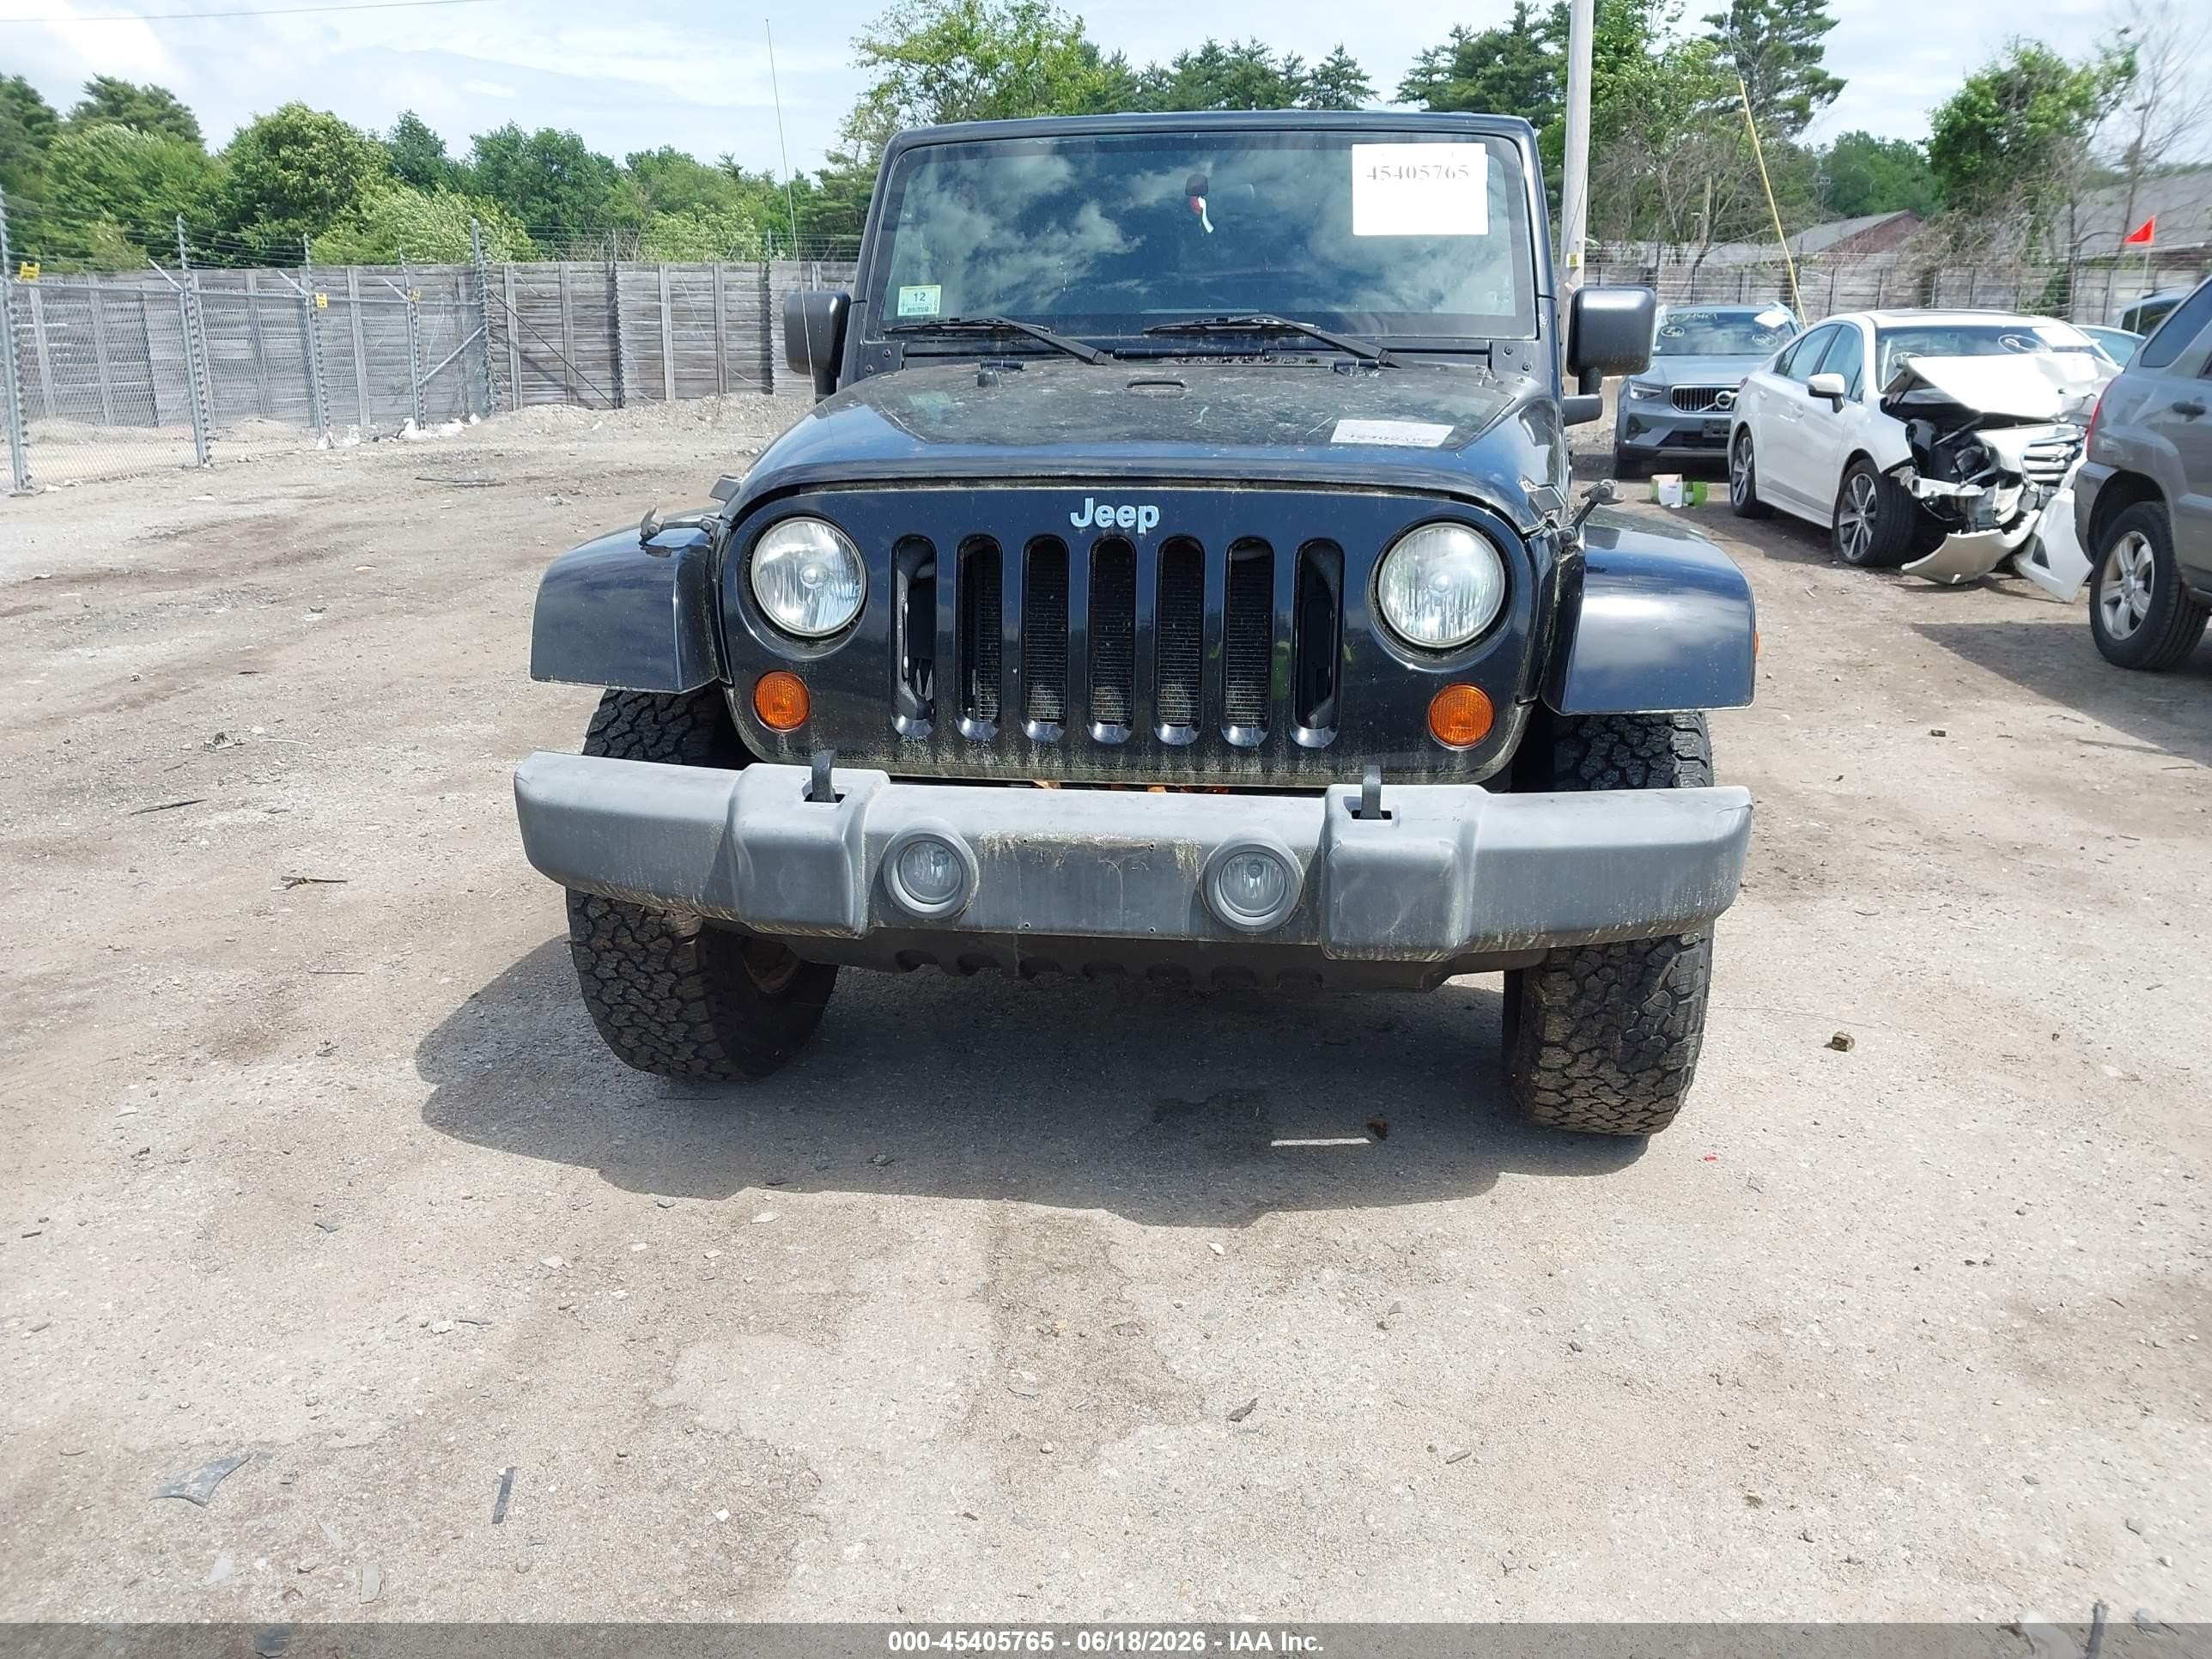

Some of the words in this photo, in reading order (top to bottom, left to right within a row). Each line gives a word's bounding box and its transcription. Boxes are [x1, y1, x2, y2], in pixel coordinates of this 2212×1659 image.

[1366, 165, 1470, 181] 45405765
[914, 292, 927, 302] 12
[1070, 497, 1160, 535] Jeep
